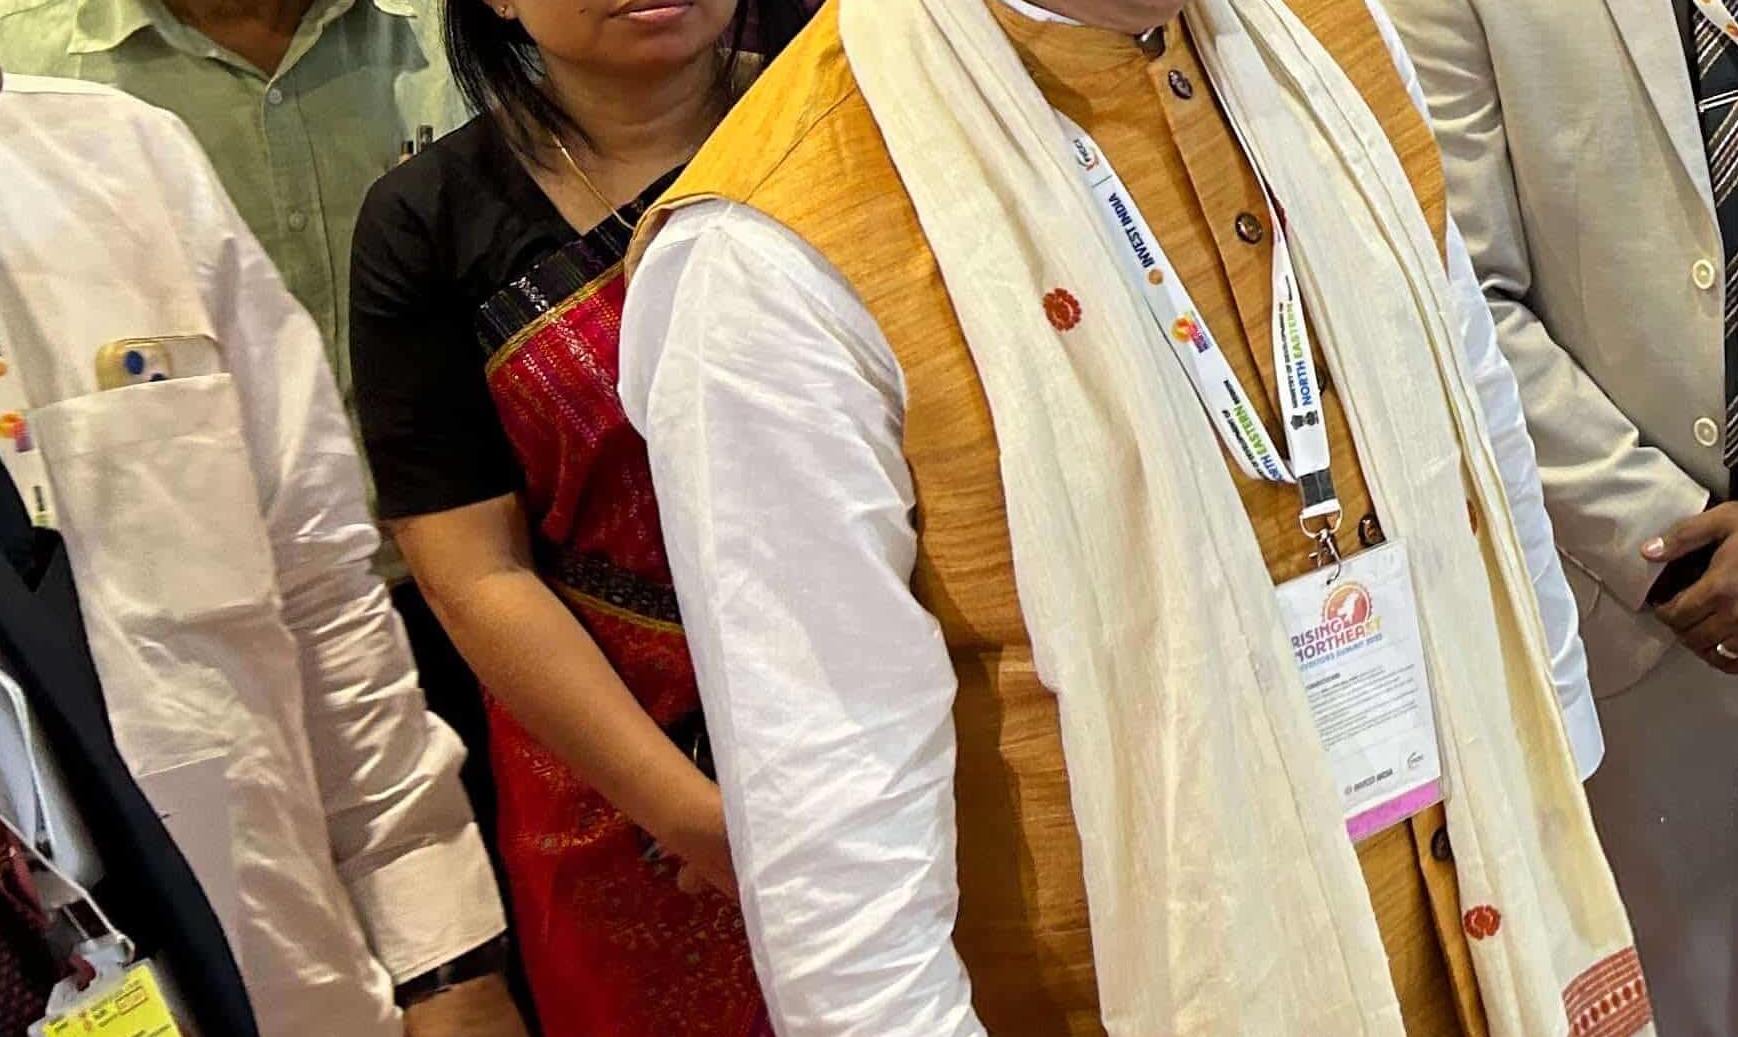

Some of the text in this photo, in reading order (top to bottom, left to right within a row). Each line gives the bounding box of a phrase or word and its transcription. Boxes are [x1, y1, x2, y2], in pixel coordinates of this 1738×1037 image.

[1107, 192, 1156, 269] INVEST INDIA
[1286, 302, 1304, 363] EASTERN
[1294, 360, 1312, 406] NORTH
[1232, 404, 1267, 460] EASTERN
[1291, 619, 1343, 649] RISING
